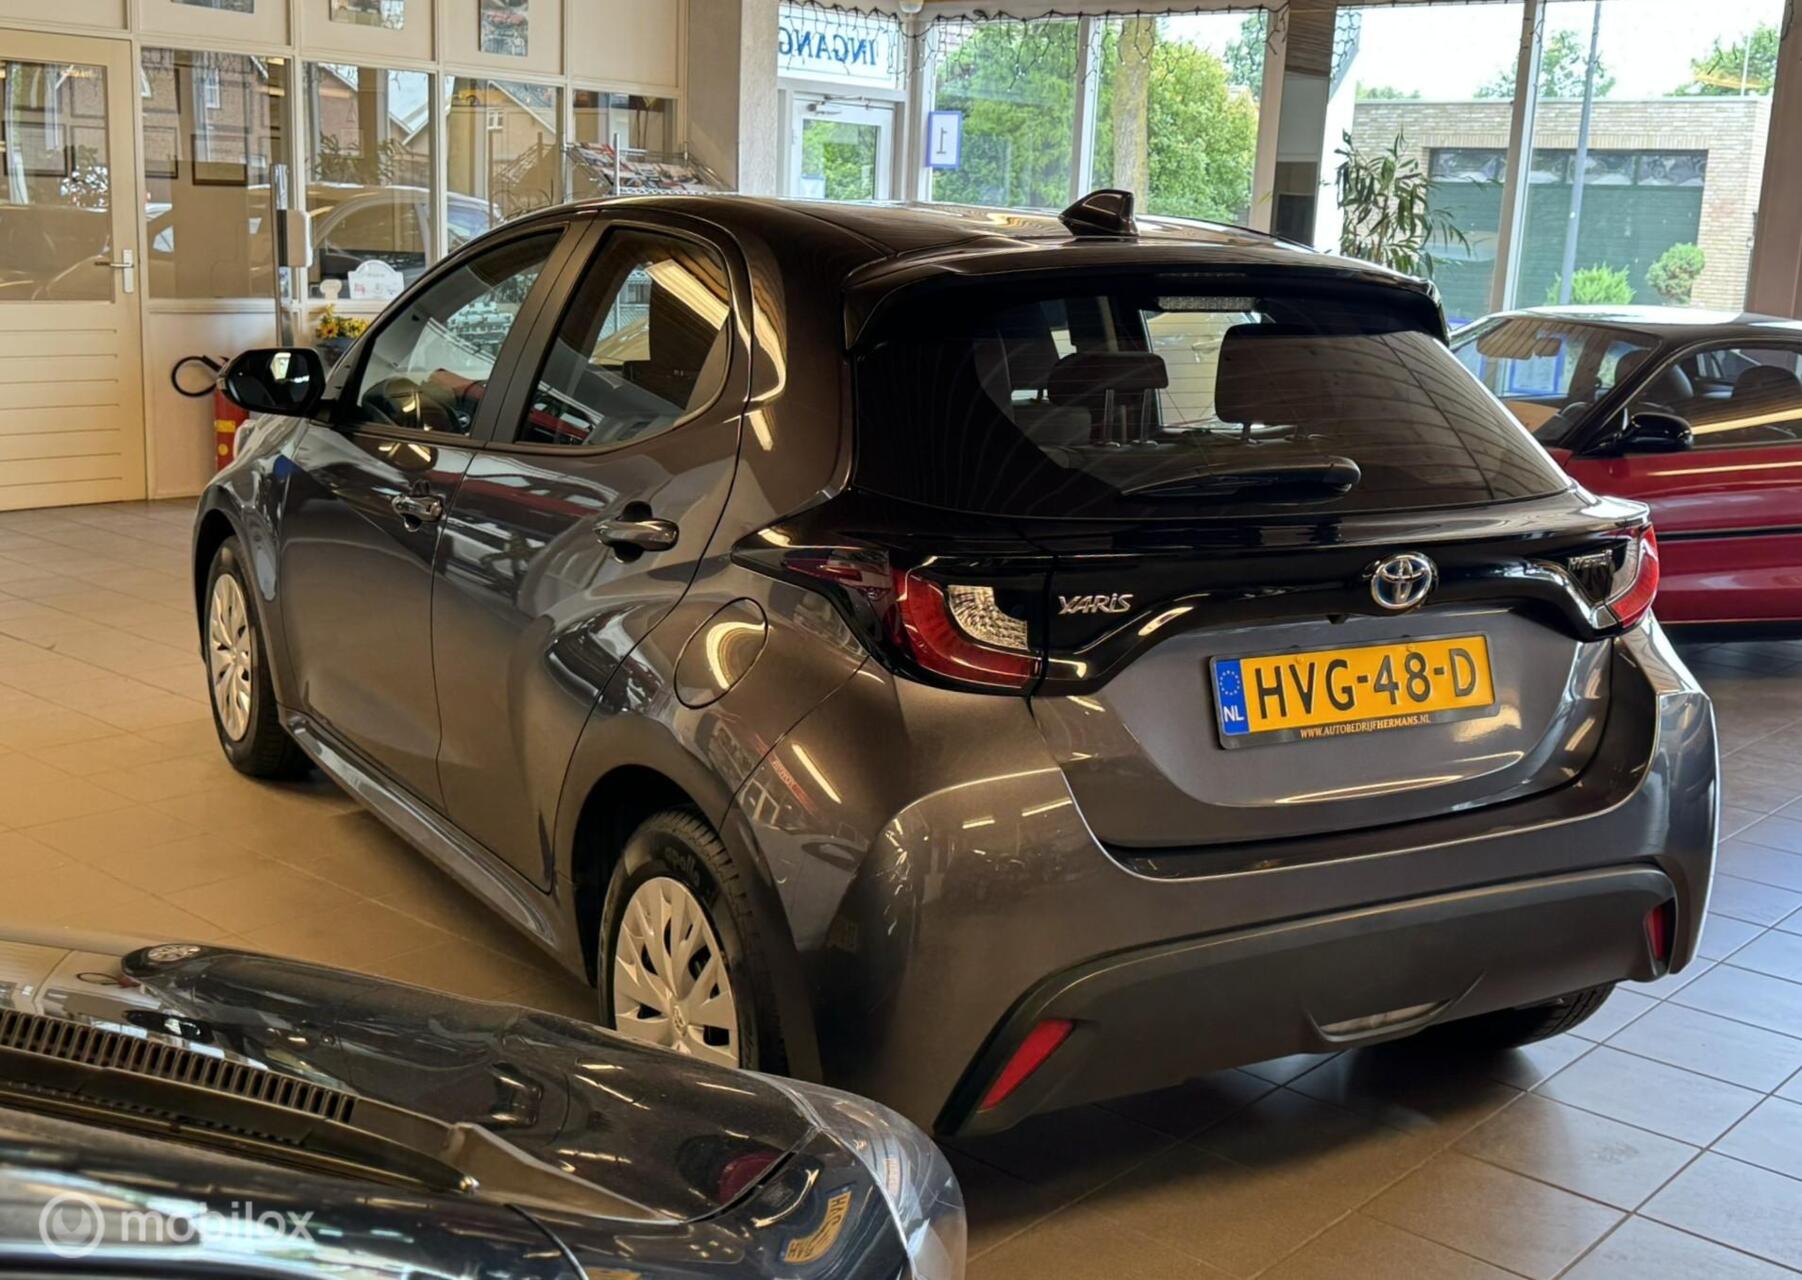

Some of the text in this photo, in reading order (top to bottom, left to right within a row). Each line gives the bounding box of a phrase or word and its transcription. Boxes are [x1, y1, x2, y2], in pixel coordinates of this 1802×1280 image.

[1254, 647, 1477, 720] HVG-48-D
[1223, 704, 1245, 723] NL
[1299, 714, 1431, 740] WWW.AUTOBEDRIJFHERMANS.NL
